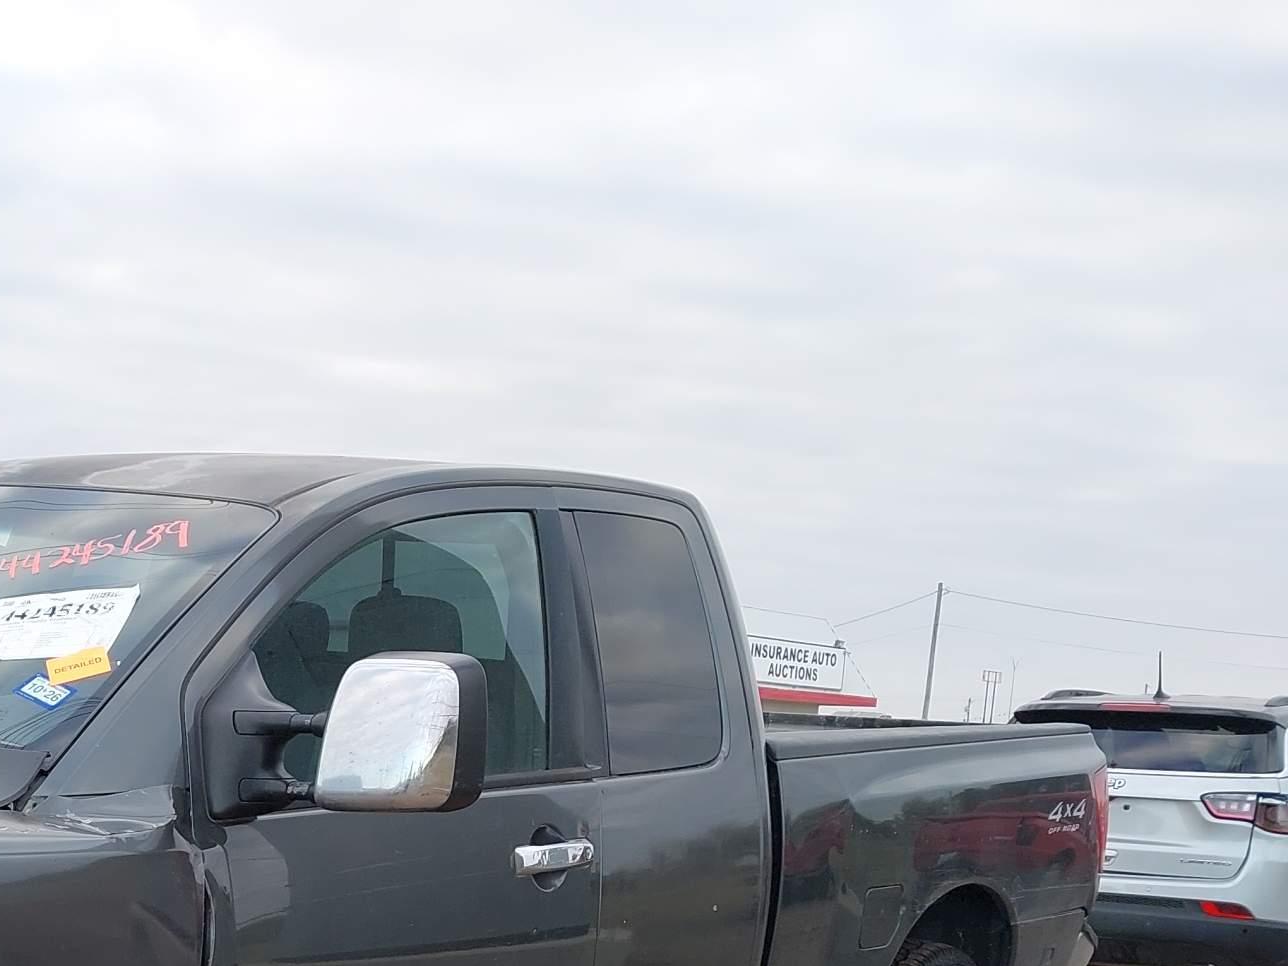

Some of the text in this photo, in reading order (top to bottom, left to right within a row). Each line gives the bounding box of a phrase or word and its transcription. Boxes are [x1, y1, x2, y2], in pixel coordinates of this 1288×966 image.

[751, 642, 837, 667] INSURANCE AUTO
[53, 656, 102, 675] DETAILED
[768, 662, 818, 682] AUCTIONS
[1108, 777, 1127, 790] ep
